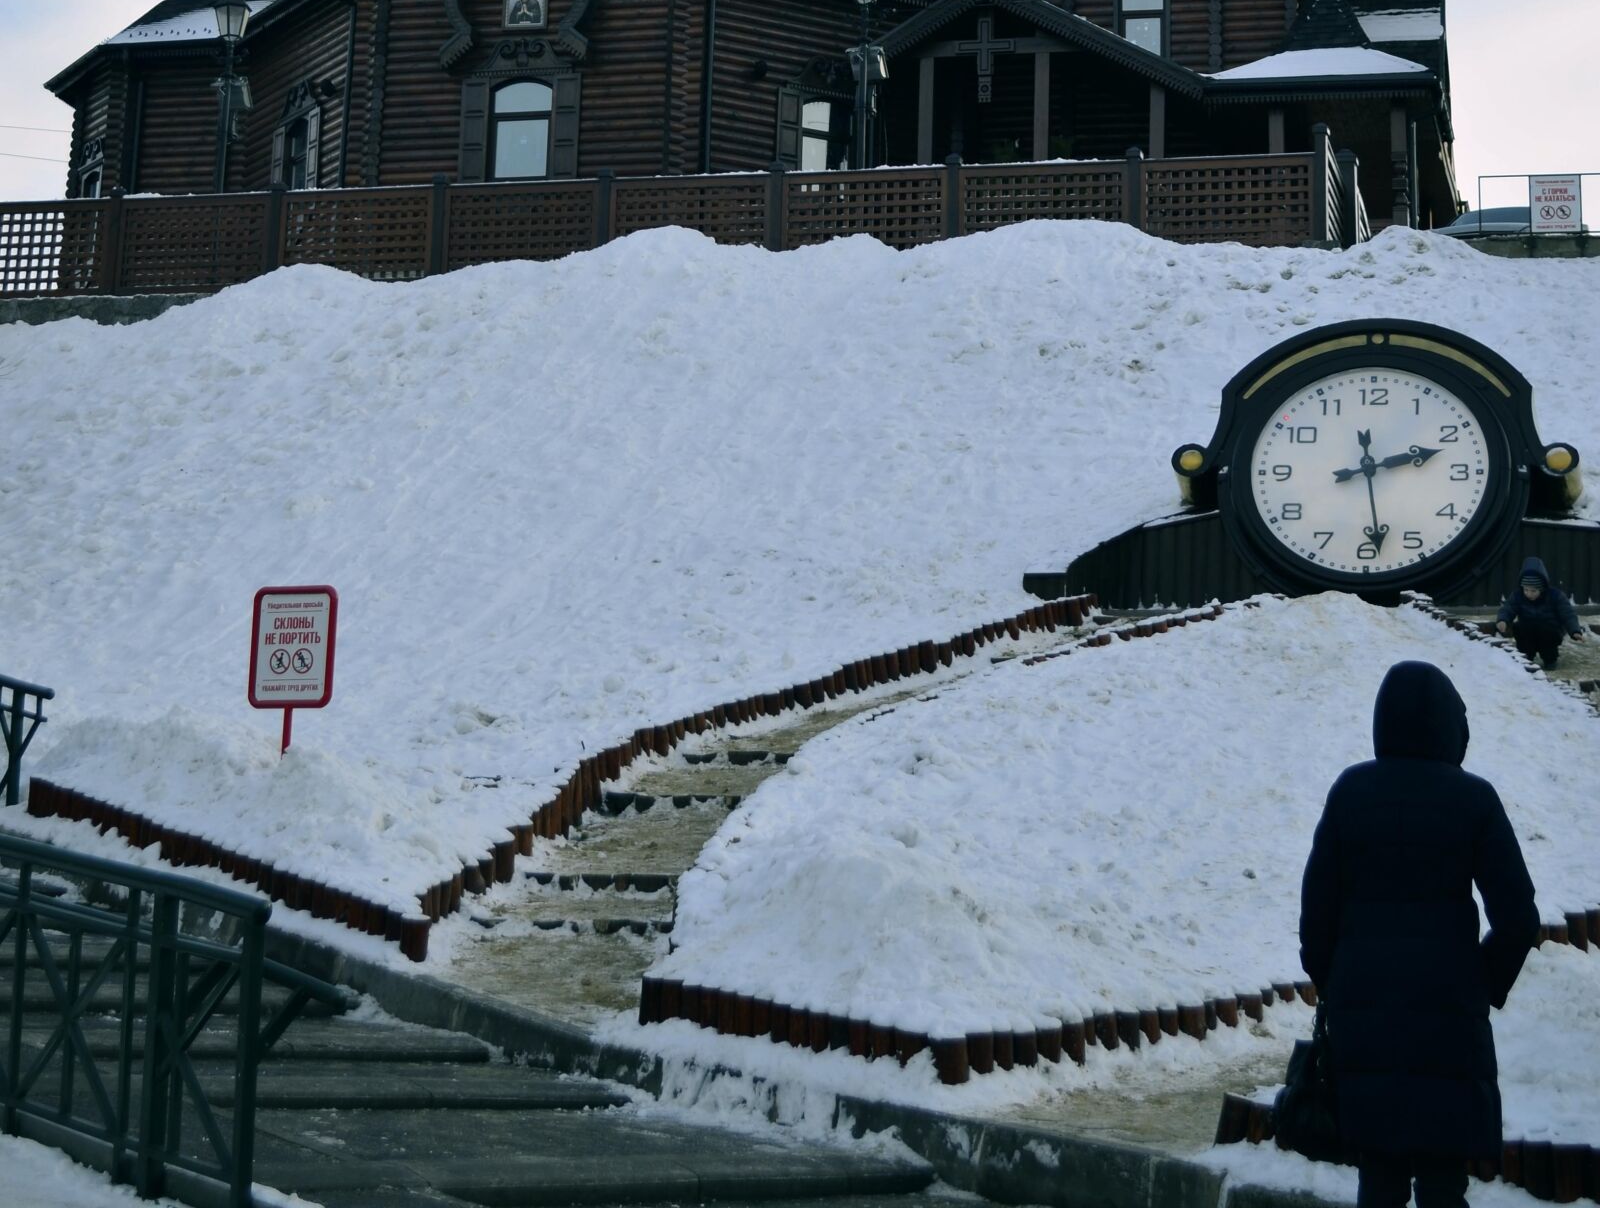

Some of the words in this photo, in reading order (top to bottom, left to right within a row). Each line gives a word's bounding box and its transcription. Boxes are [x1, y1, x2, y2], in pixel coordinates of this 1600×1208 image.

[1358, 388, 1389, 406] 12
[1319, 398, 1341, 416] 11
[1411, 398, 1420, 415] 1
[1287, 426, 1317, 444] 10
[1439, 425, 1459, 443] 2
[1272, 465, 1292, 482] 9
[1450, 464, 1469, 481] 3
[1281, 503, 1302, 521] 8
[1435, 503, 1458, 520] 4
[1314, 532, 1334, 549] 7
[1402, 531, 1423, 549] 5
[1356, 542, 1377, 560] 6
[274, 617, 315, 630] СКЛОНЫ
[265, 632, 278, 645] НЕ
[279, 631, 321, 645] ПОРТИТЬ
